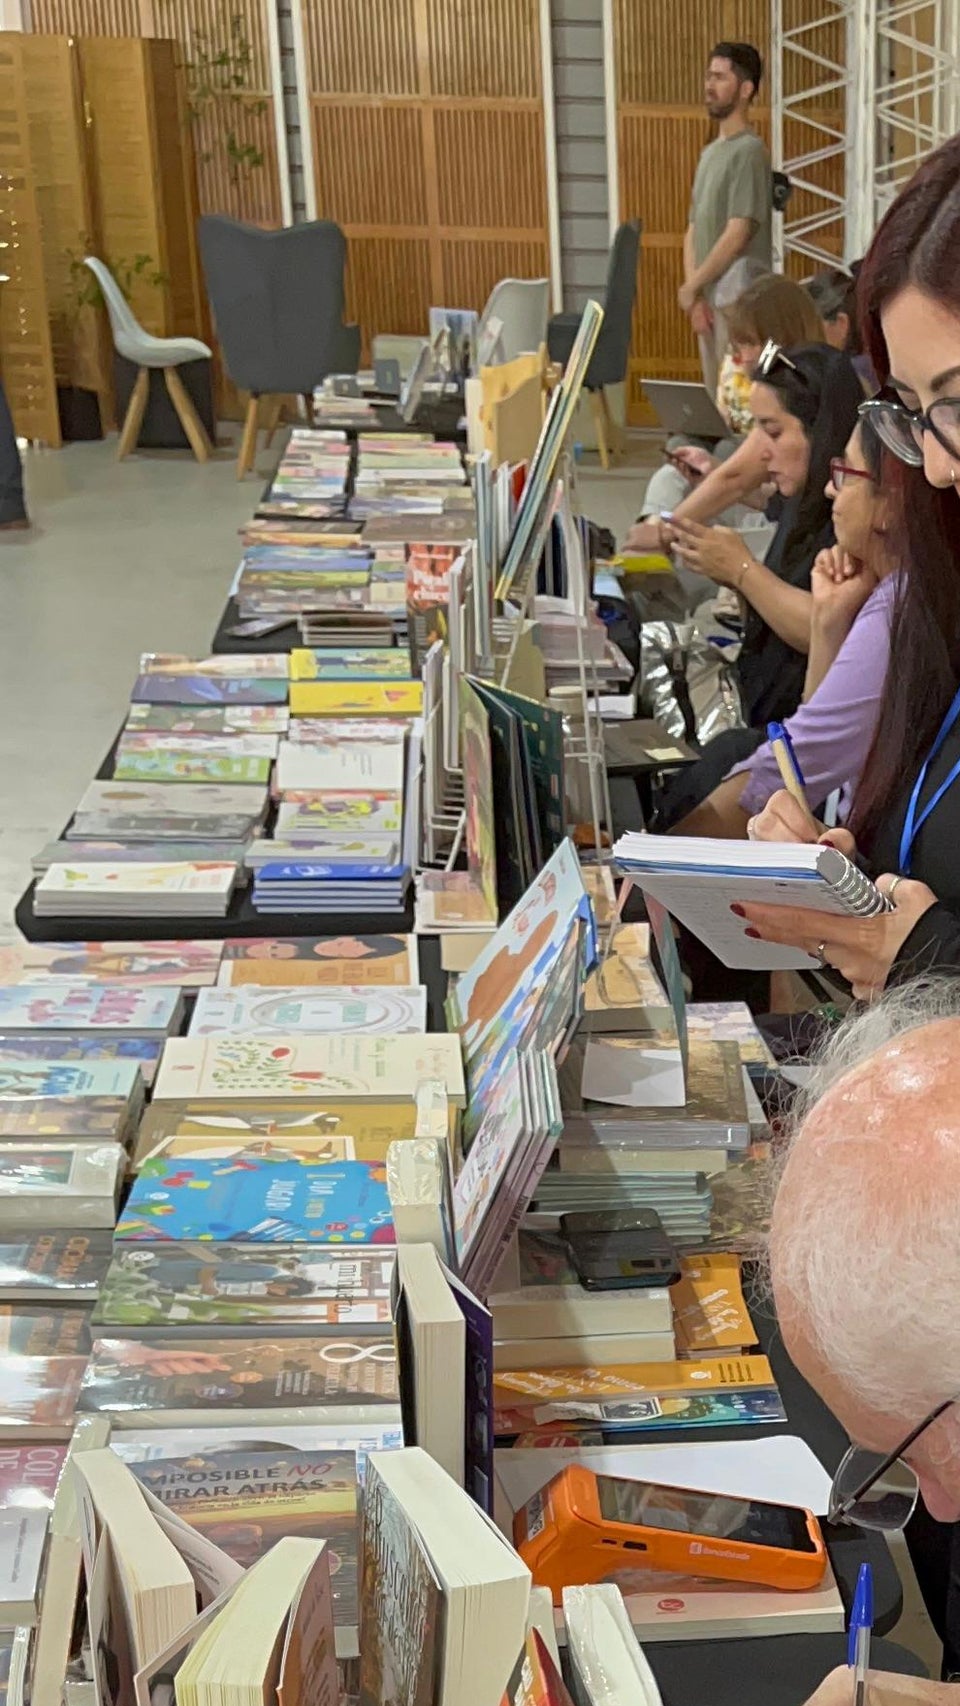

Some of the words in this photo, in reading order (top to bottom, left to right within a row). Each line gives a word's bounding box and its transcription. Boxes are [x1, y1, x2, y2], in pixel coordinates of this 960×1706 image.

[144, 1467, 280, 1486] MPOSIBLE
[287, 1463, 333, 1477] NO
[238, 1478, 327, 1496] ATRÁS
